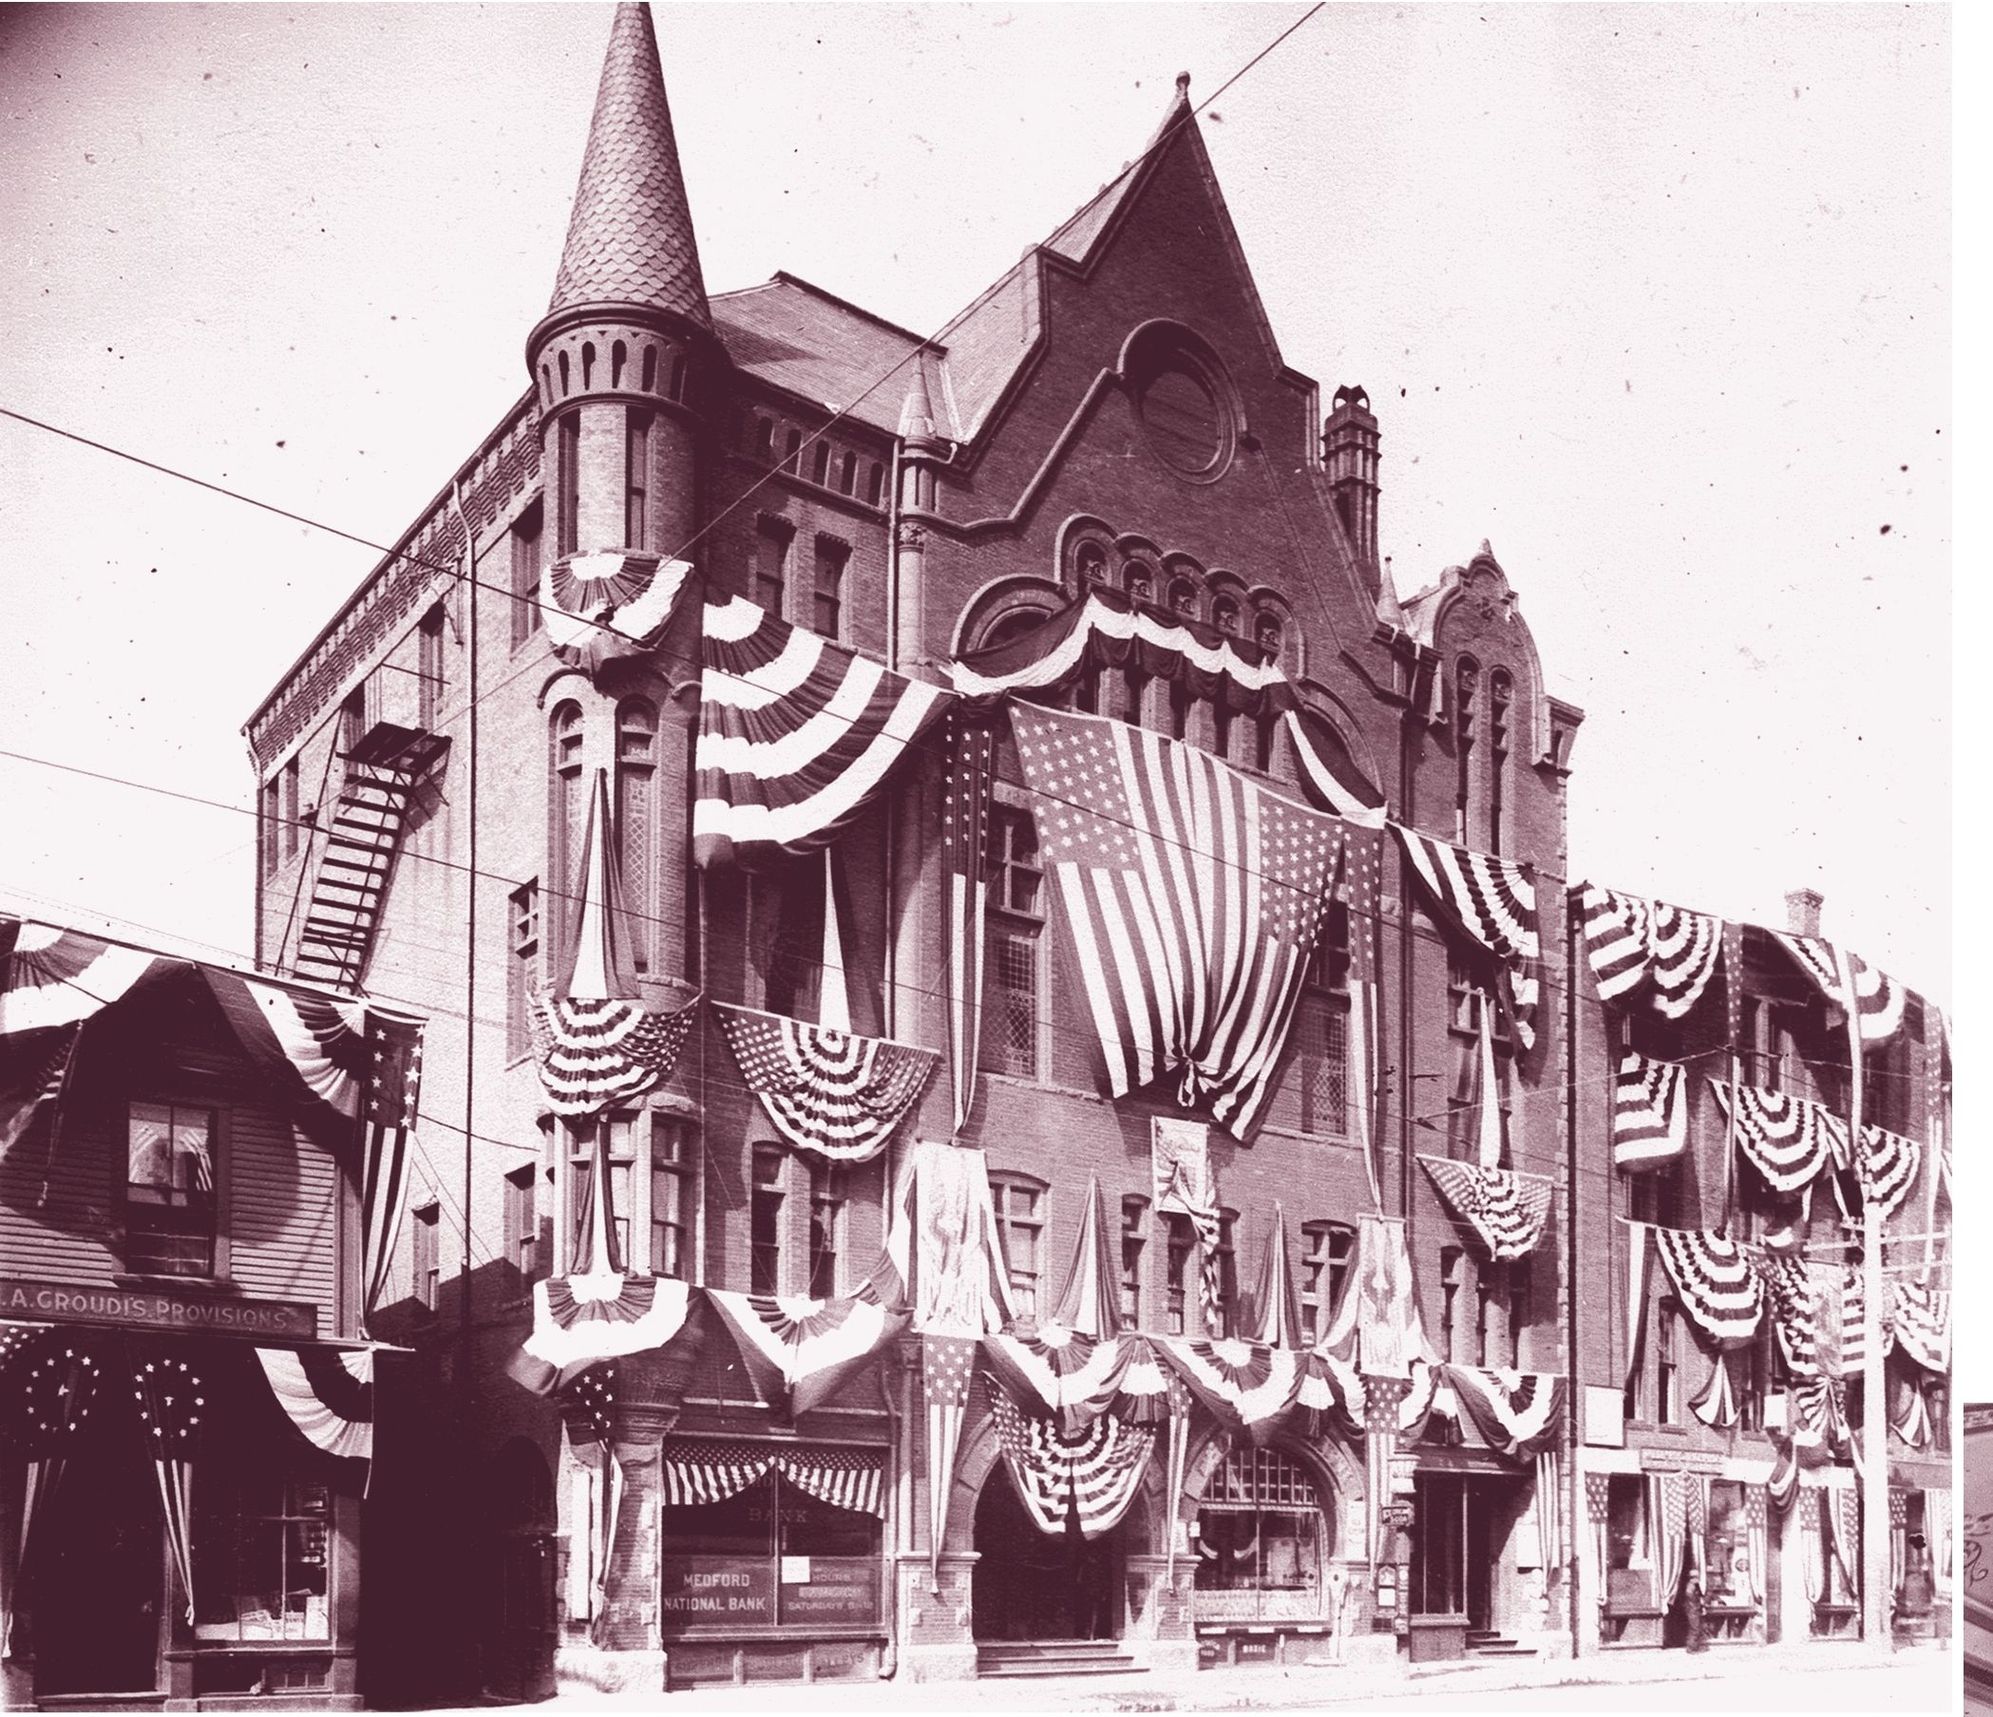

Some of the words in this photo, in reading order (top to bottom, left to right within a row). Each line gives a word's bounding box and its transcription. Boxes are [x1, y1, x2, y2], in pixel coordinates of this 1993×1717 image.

[156, 1299, 288, 1329] PROVISIONS
[747, 1507, 808, 1523] BANK
[683, 1573, 750, 1588] MEDFORD
[663, 1597, 725, 1611] NATIONAL
[728, 1597, 766, 1611] BANK
